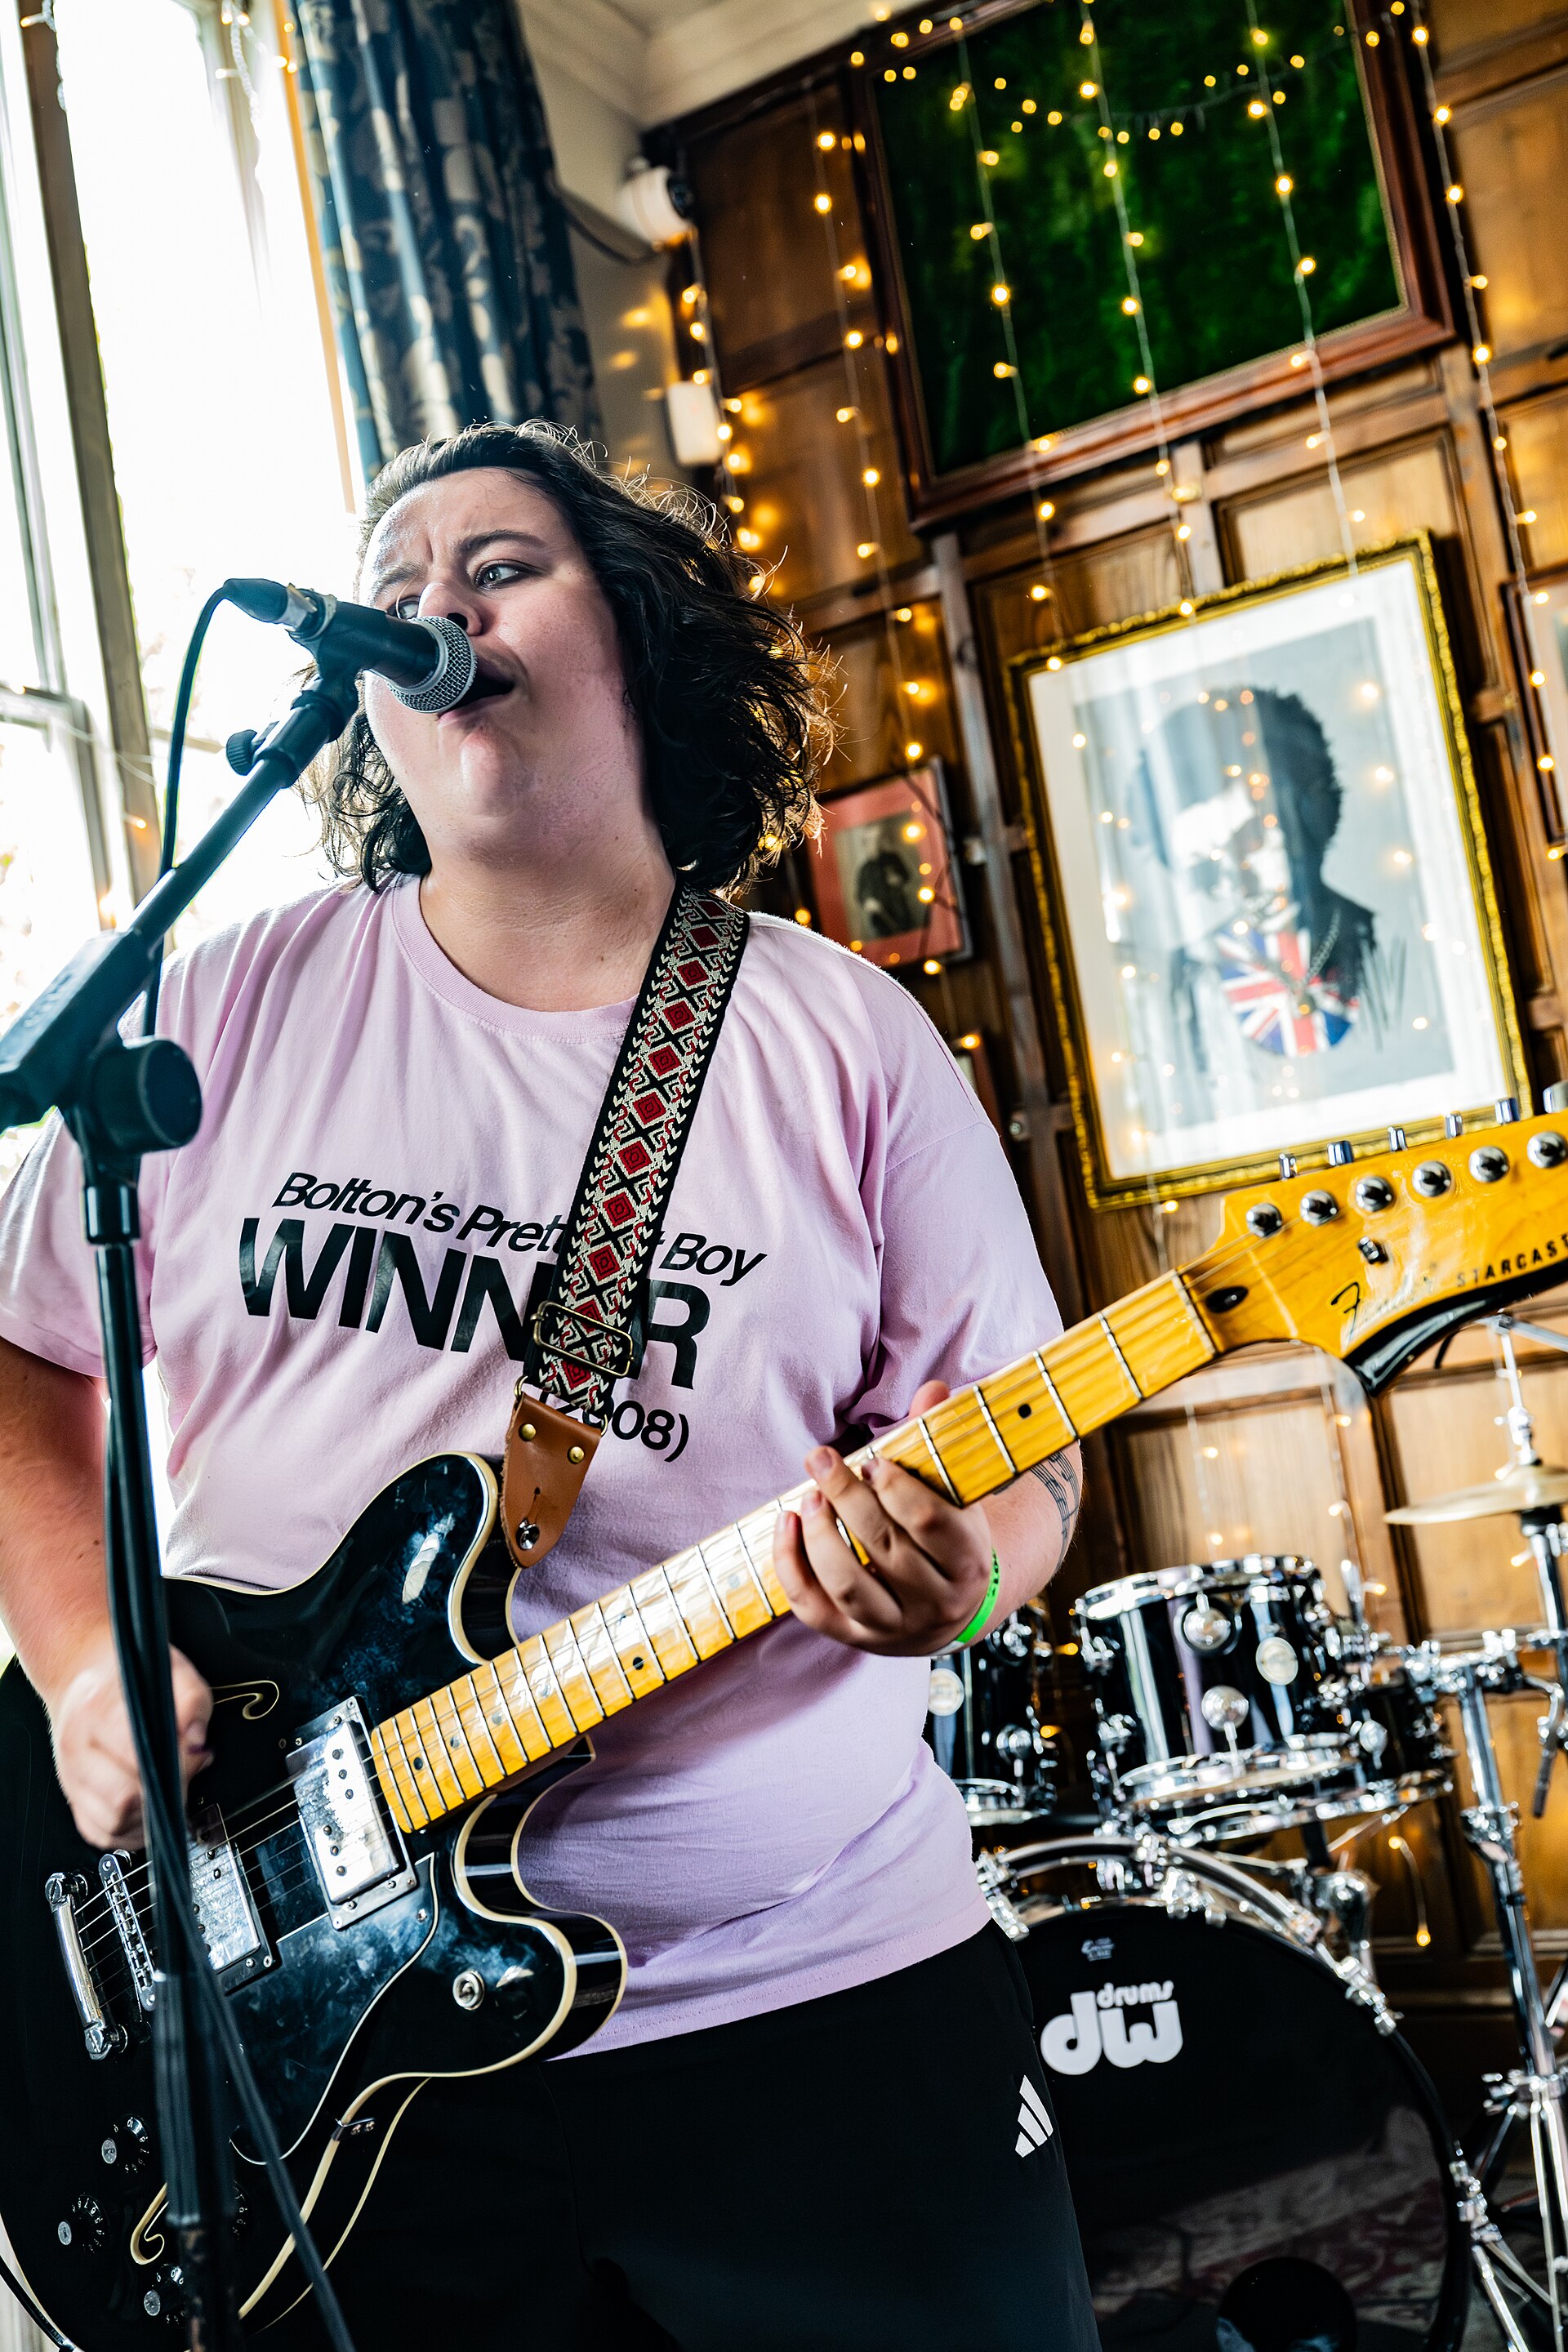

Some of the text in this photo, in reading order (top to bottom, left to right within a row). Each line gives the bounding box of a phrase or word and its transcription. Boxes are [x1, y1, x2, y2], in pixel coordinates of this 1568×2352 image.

[271, 1172, 460, 1233] Bolton's
[658, 1232, 768, 1287] Boy
[238, 1217, 710, 1390] WINNR
[1040, 1990, 1183, 2076] dw
[1096, 1980, 1174, 2009] drums
